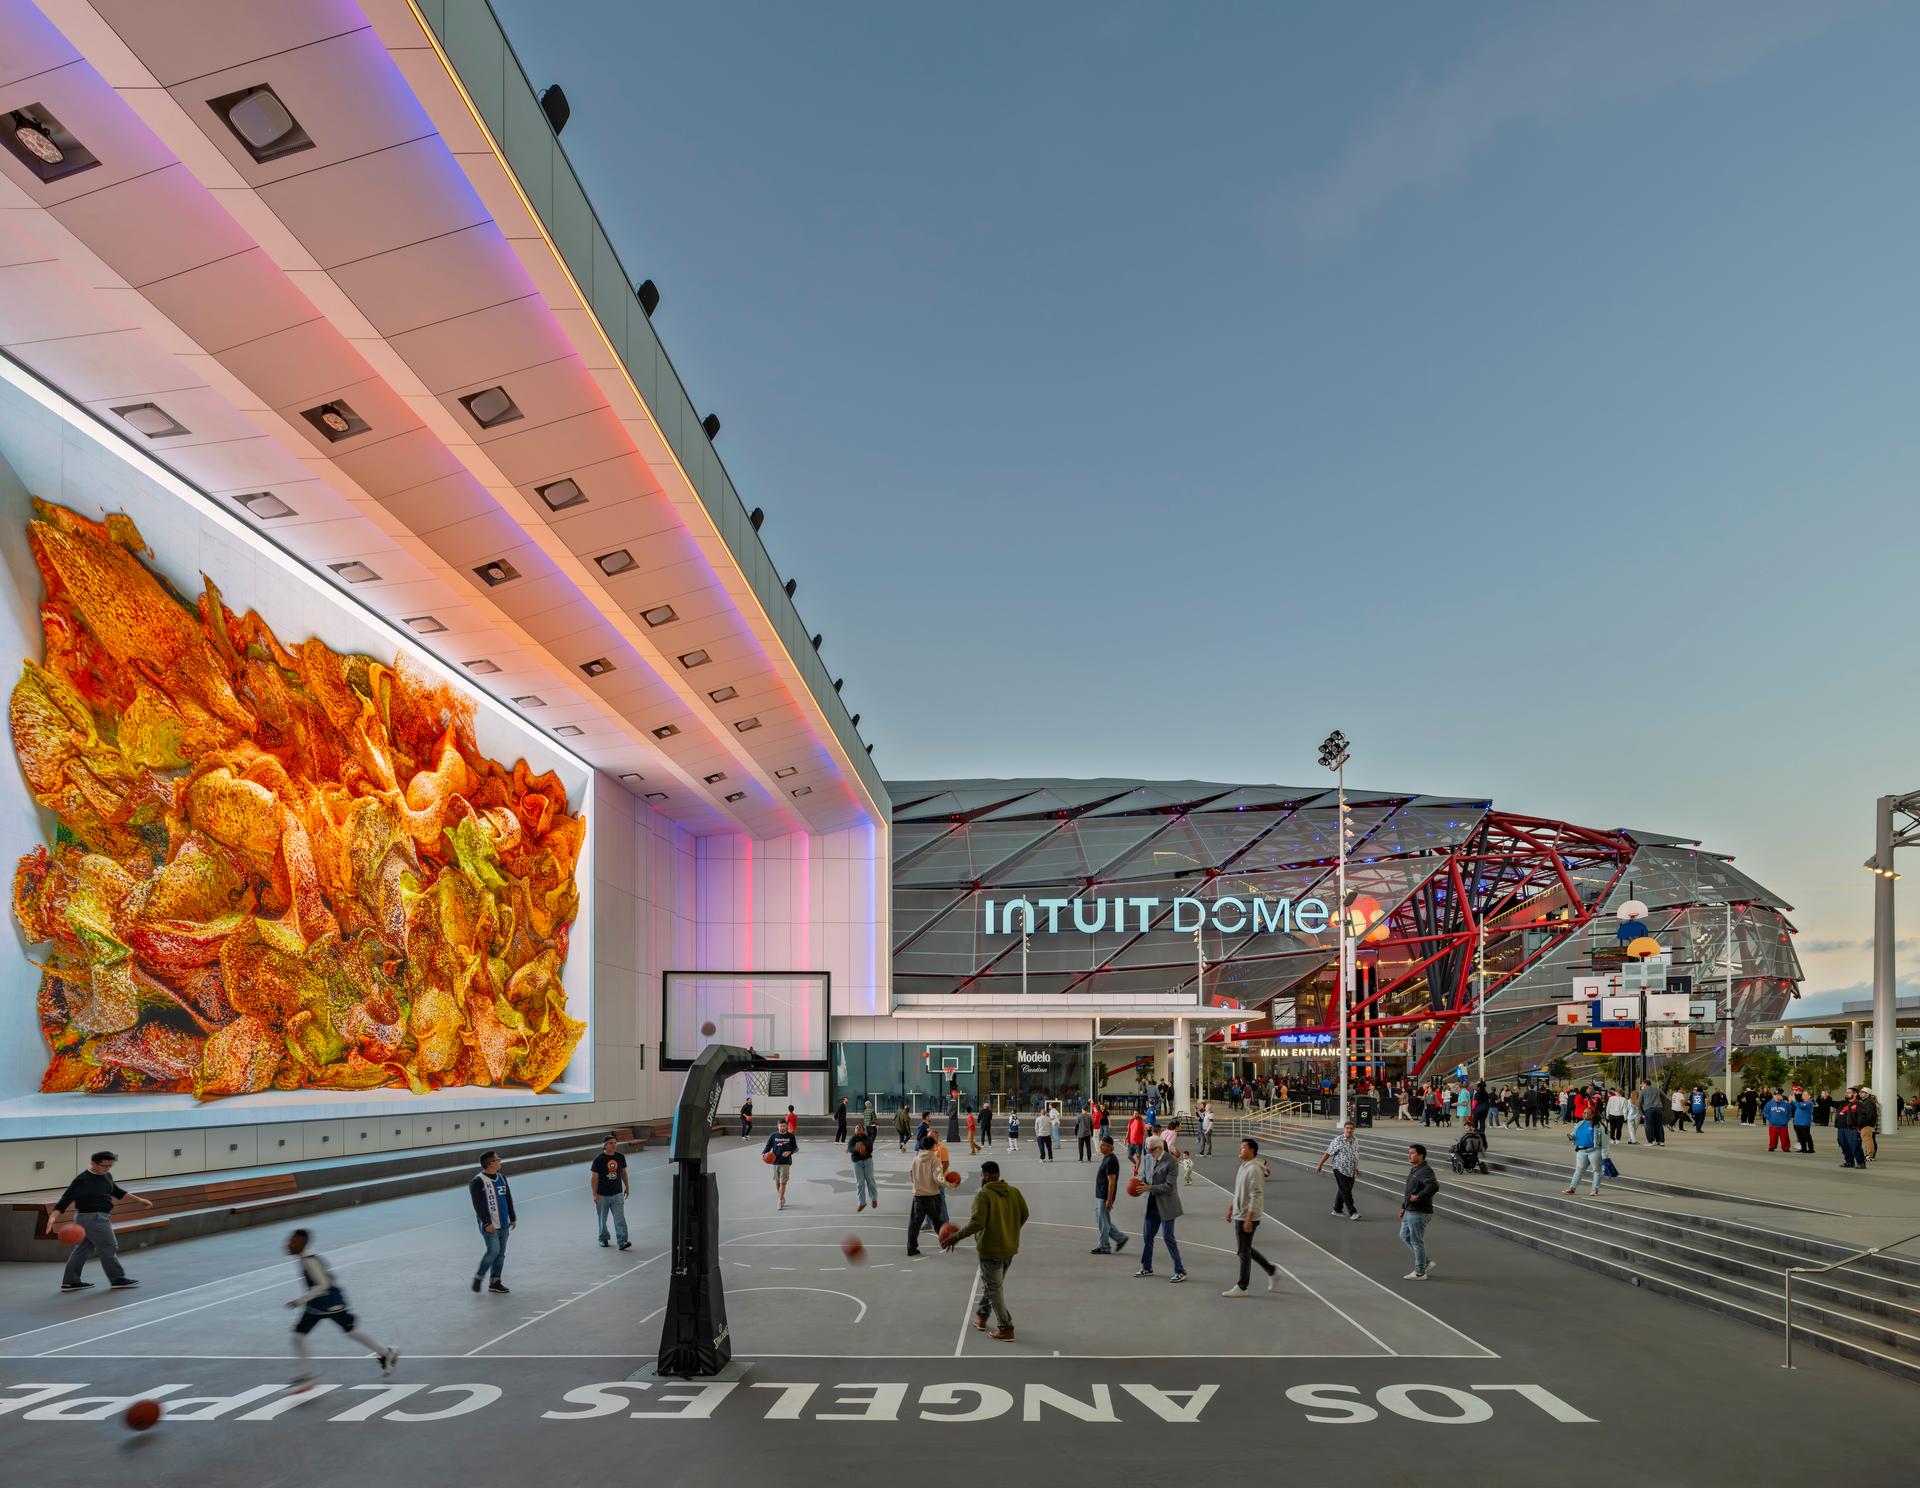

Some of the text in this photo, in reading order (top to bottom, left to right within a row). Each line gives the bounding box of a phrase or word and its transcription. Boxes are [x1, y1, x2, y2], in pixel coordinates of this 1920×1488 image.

[1017, 1050, 1051, 1063] Modelo
[1261, 1048, 1288, 1057] MAIN
[540, 1381, 1220, 1423] ANGELES
[1285, 1383, 1600, 1425] LOS
